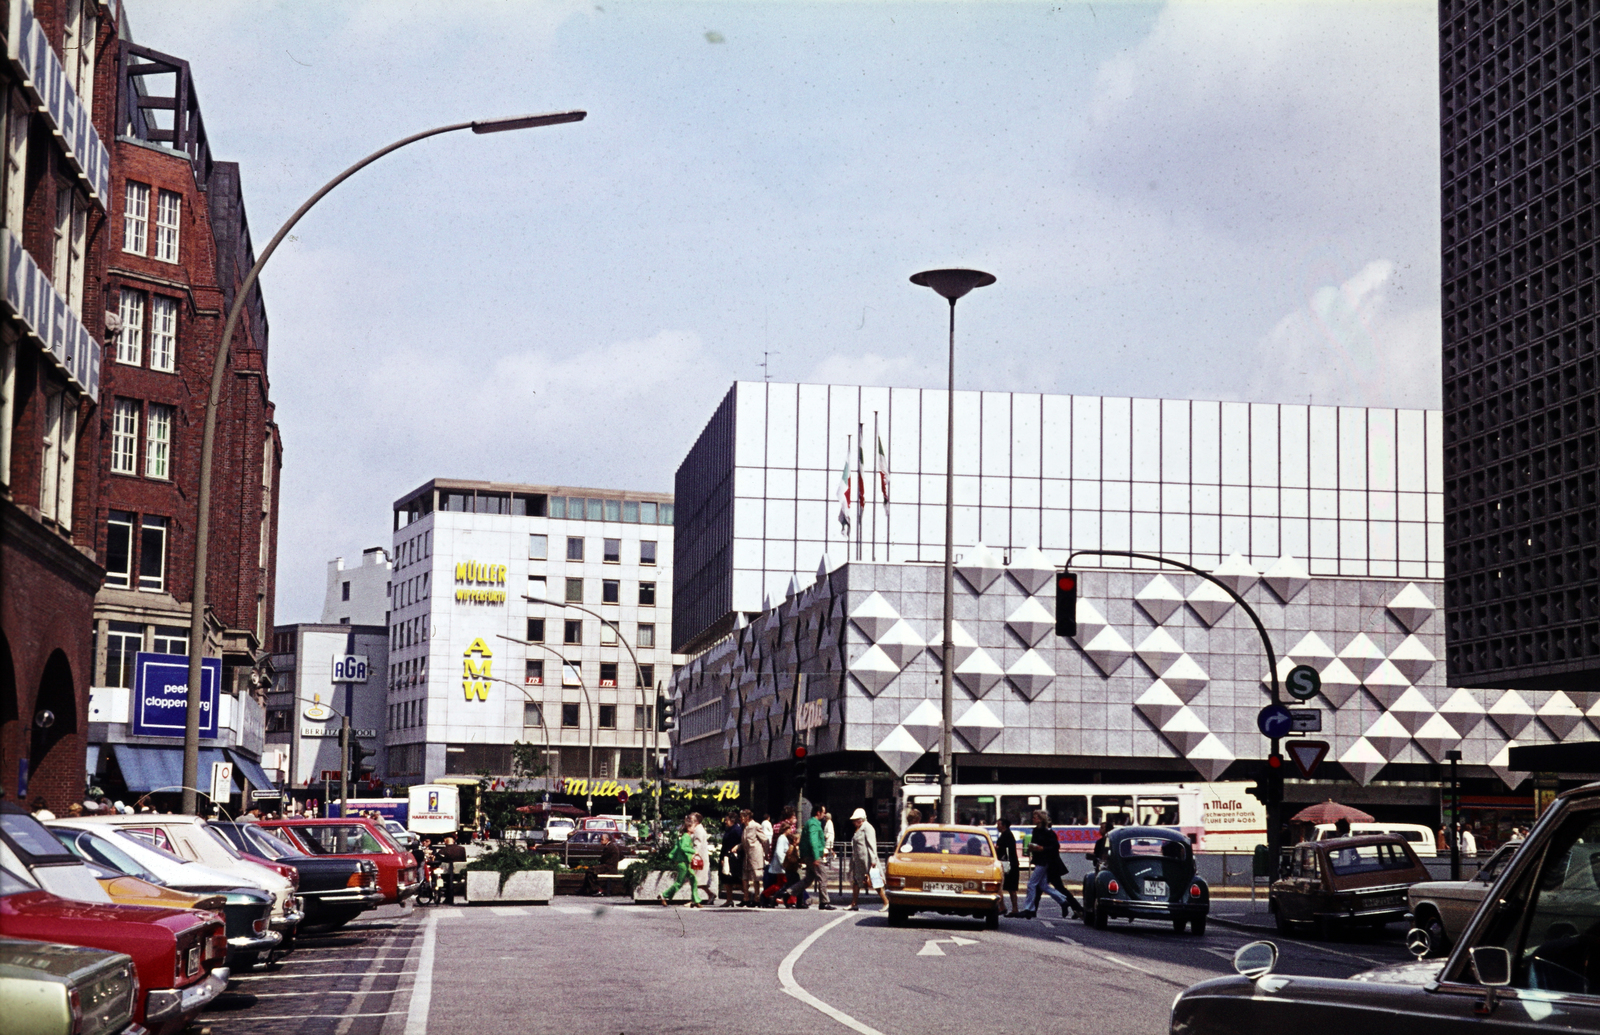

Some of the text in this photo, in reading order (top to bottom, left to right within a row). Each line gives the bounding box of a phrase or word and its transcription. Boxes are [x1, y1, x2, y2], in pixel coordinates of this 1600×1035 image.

[455, 560, 507, 584] MÜLLER
[335, 656, 366, 679] AGA
[1293, 669, 1314, 695] S
[145, 696, 210, 712] cloppenrg
[304, 728, 339, 736] BERLITZ
[1056, 829, 1102, 842] GSRAM
